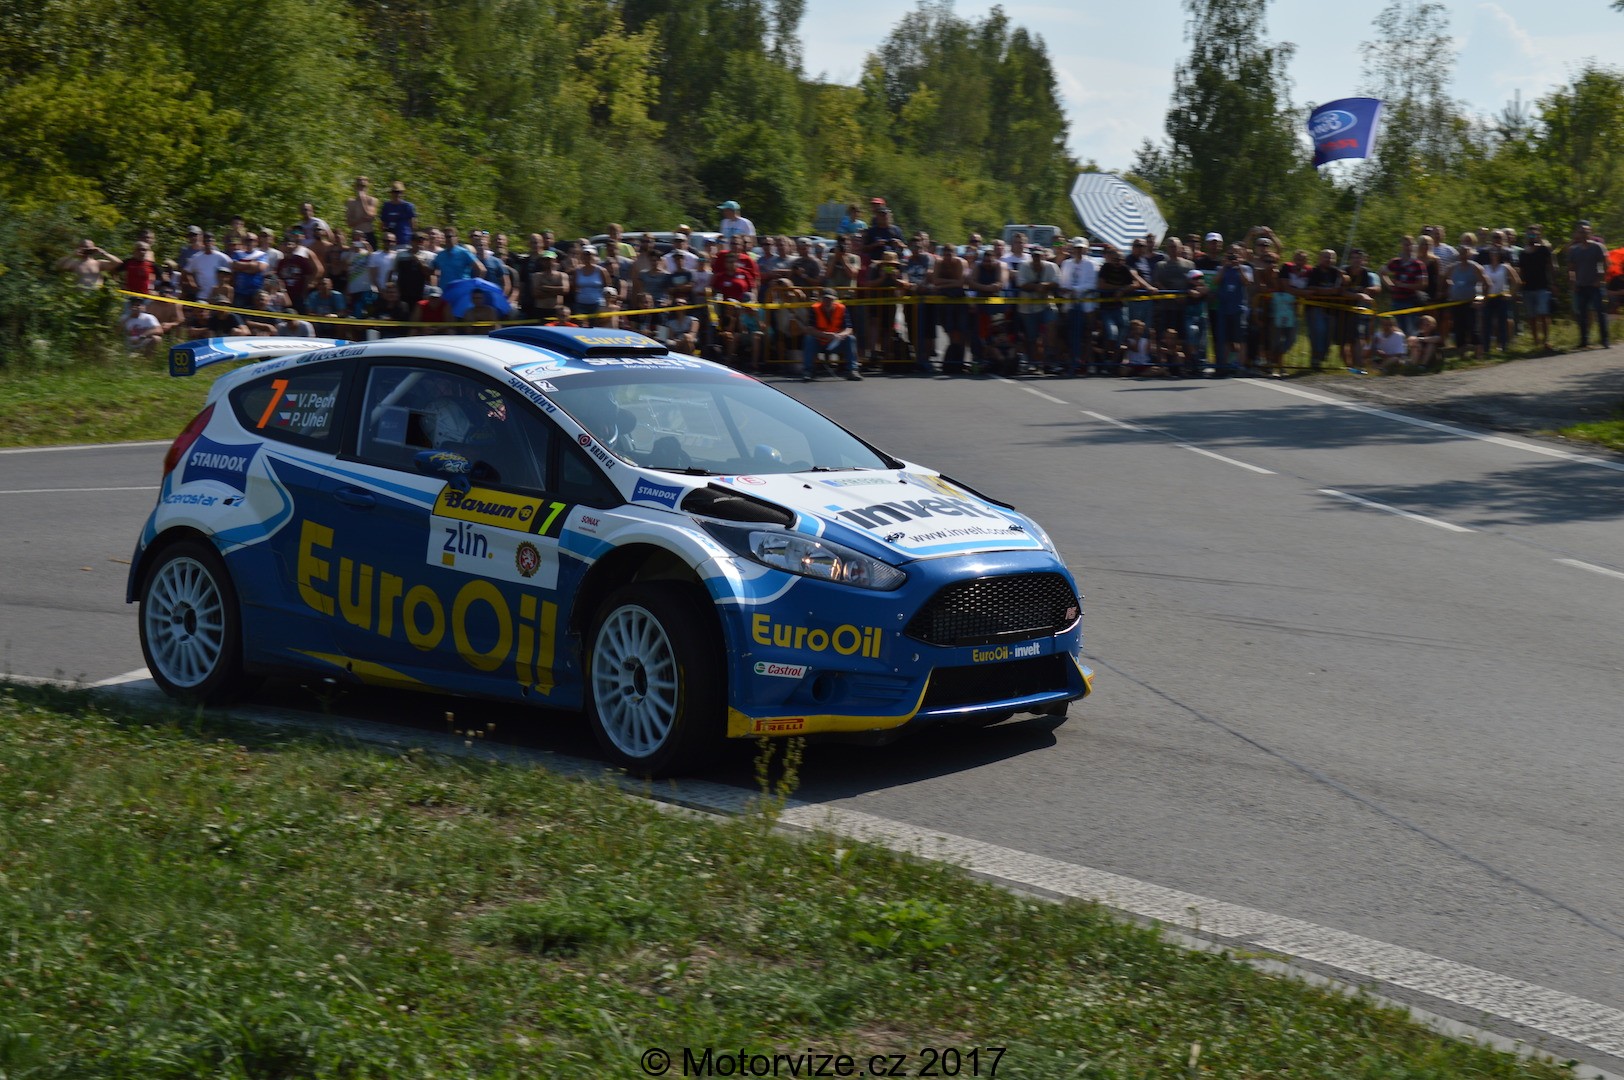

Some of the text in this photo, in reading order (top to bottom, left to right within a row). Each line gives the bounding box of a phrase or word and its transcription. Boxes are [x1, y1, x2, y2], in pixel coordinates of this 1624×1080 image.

[508, 377, 557, 414] speedpro
[190, 452, 247, 472] STANDOX
[444, 491, 518, 518] Barum
[637, 486, 677, 500] STANDOX
[581, 515, 600, 526] SONAX
[824, 496, 1000, 529] invelt
[297, 519, 558, 696] EuroOil
[752, 613, 882, 658] EuroOil
[972, 646, 1009, 662] EuroOil
[1014, 642, 1041, 658] invelt
[767, 664, 803, 677] Castrol
